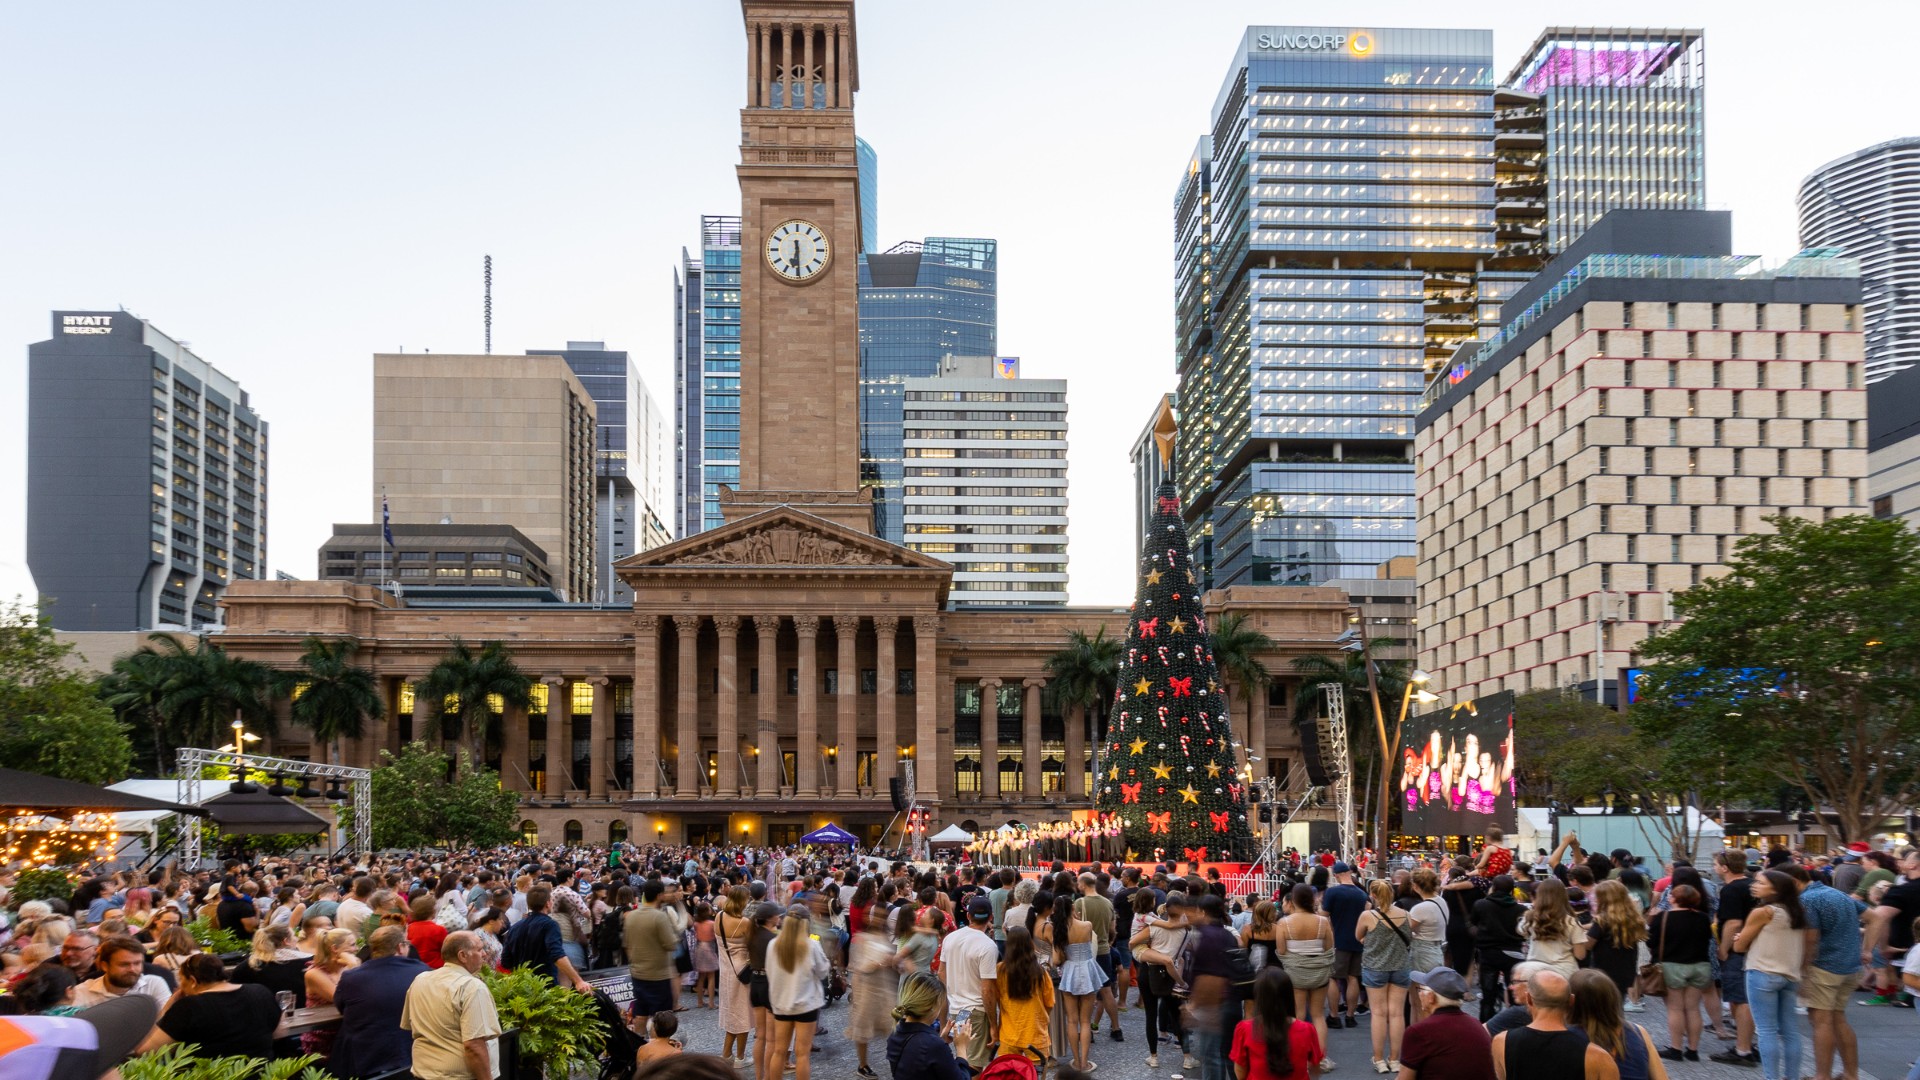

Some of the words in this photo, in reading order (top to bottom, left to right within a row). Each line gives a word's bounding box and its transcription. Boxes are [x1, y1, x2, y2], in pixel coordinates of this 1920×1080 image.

[1258, 34, 1346, 50] SUNCORP
[63, 315, 113, 326] HYATT
[63, 326, 113, 335] REGENCY
[603, 982, 634, 995] DRINKS
[609, 991, 635, 1002] INNER
